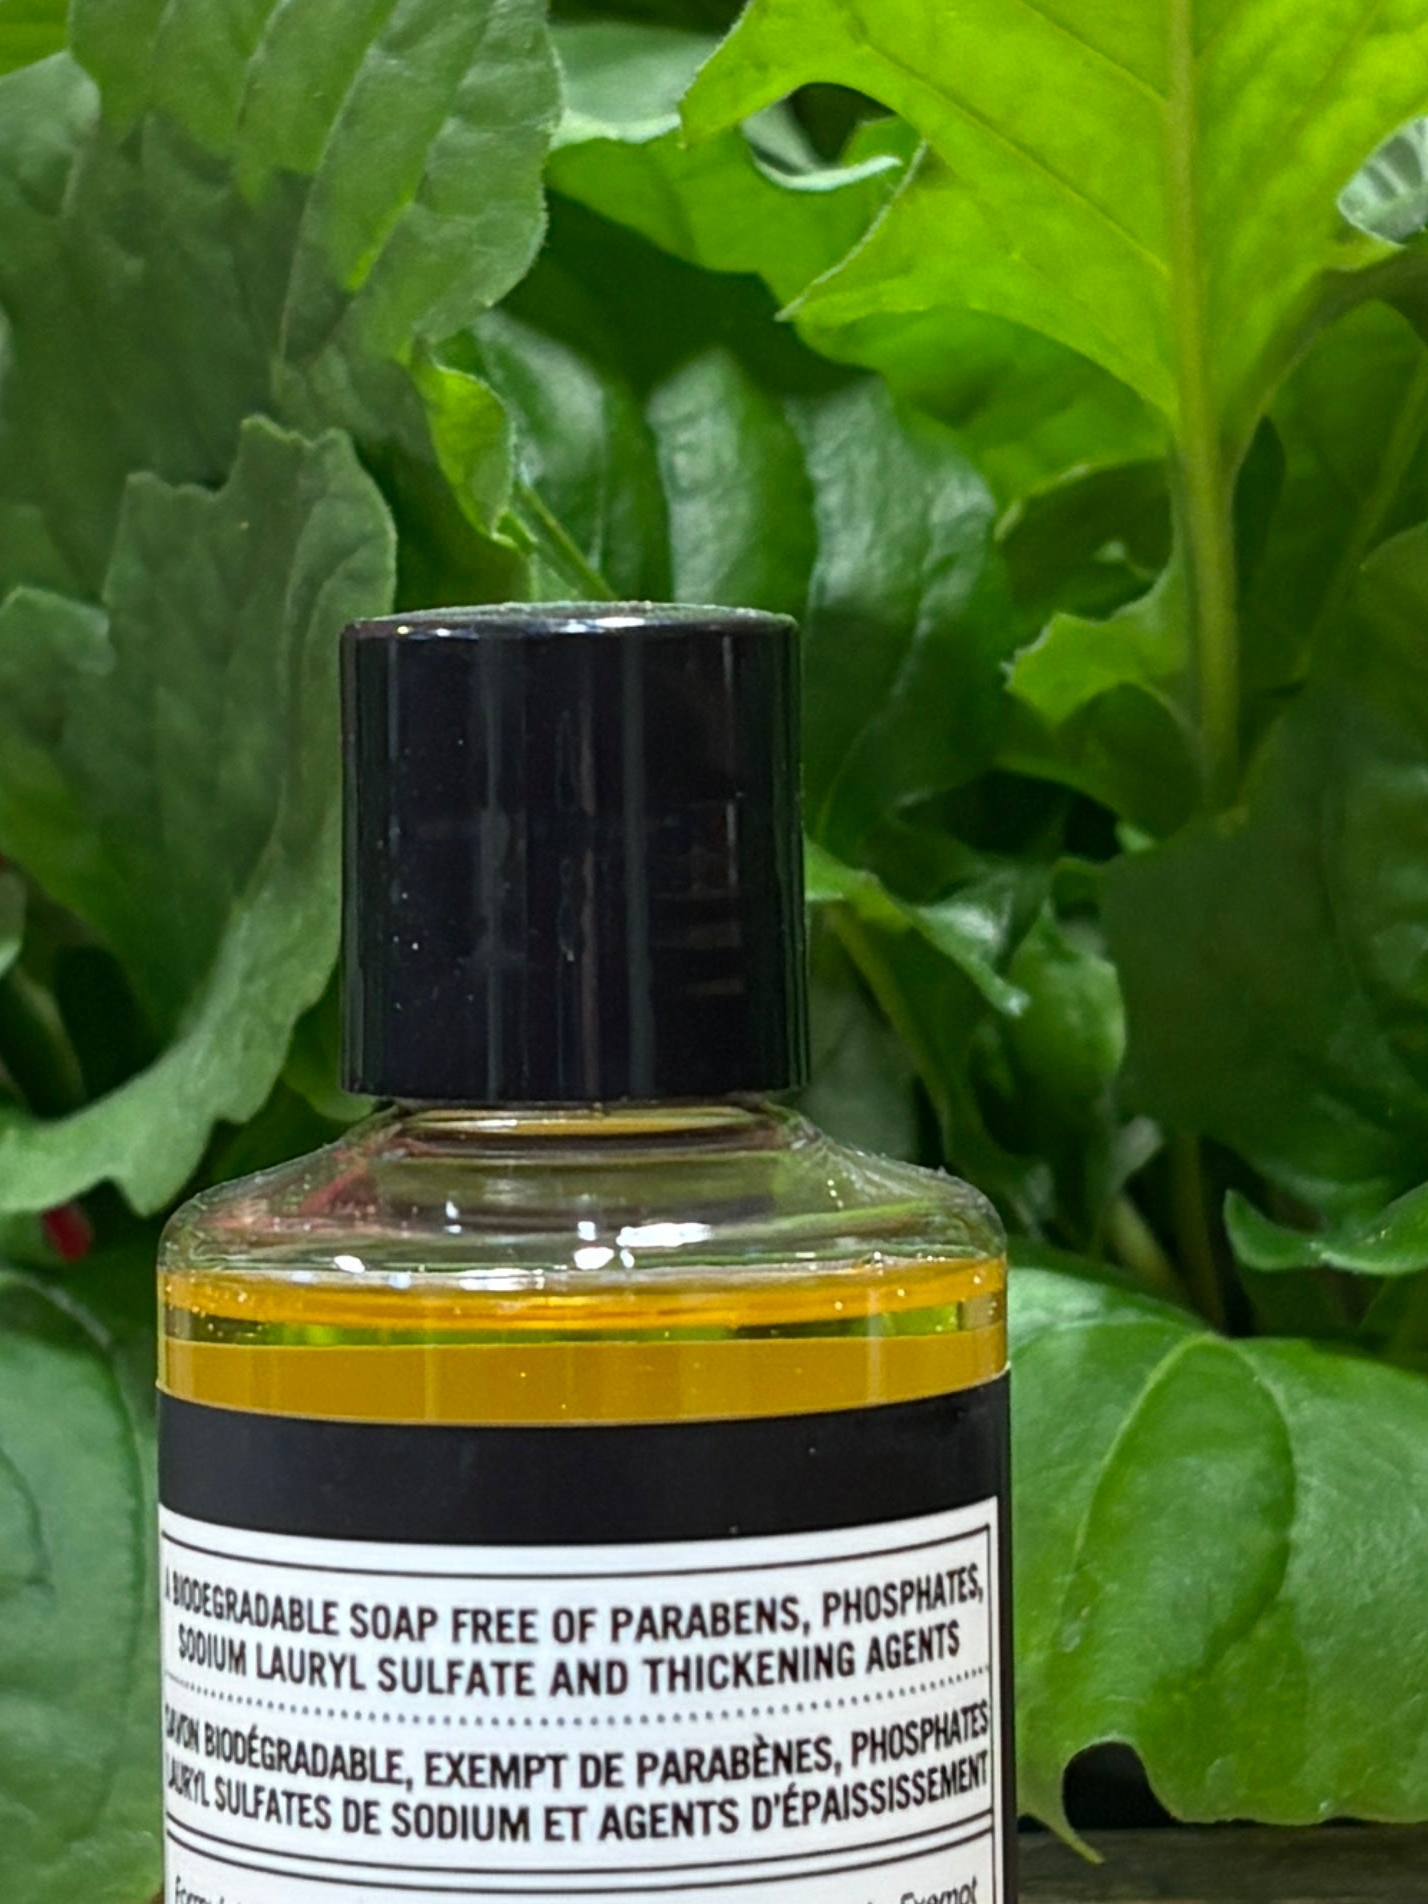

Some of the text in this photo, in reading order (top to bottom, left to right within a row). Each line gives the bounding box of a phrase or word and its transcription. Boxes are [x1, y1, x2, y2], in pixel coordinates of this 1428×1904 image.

[349, 1601, 440, 1643] SOAP
[451, 1606, 540, 1646] FREE
[551, 1606, 599, 1646] OF
[609, 1594, 812, 1645] PARABENS,
[821, 1561, 984, 1629] PHOSPHATES,
[178, 1618, 961, 1698] SODIUM LAURYL SULFATE AND THICKENING AGENTS
[203, 1699, 991, 1794] BIODÉGRADABLE, EXEMPT DE PARABÈNES, PHOSPHATES
[214, 1774, 333, 1832] SULFATES
[342, 1796, 382, 1837] DE
[390, 1800, 531, 1843] SODIUM
[543, 1804, 589, 1843] ET
[596, 1796, 740, 1842] AGENTS
